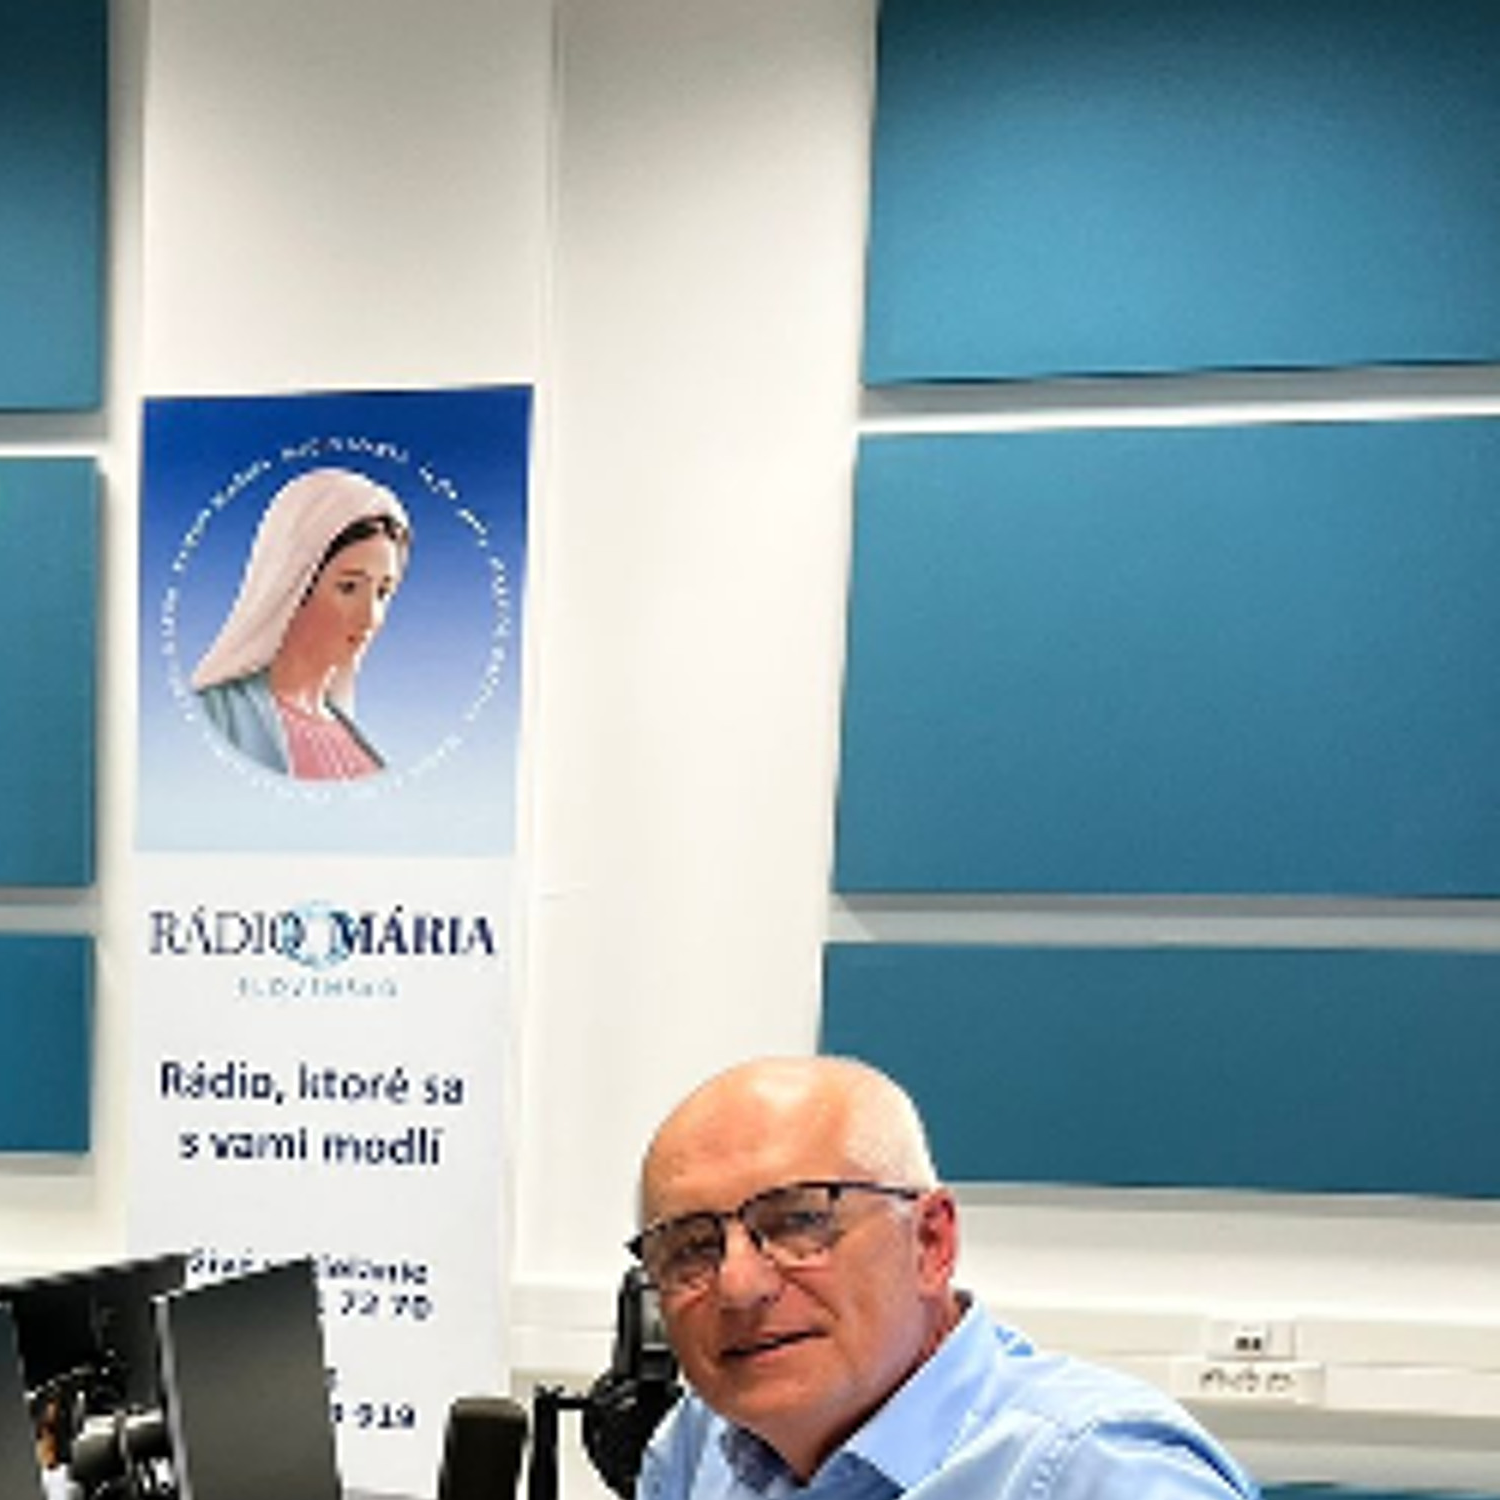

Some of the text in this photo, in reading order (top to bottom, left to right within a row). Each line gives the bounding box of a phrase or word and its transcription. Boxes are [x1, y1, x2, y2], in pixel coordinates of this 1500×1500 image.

[329, 903, 495, 955] MÁRIA
[160, 1061, 465, 1105] Rádio, ktoré sa
[178, 1127, 444, 1166] s vami modlí
